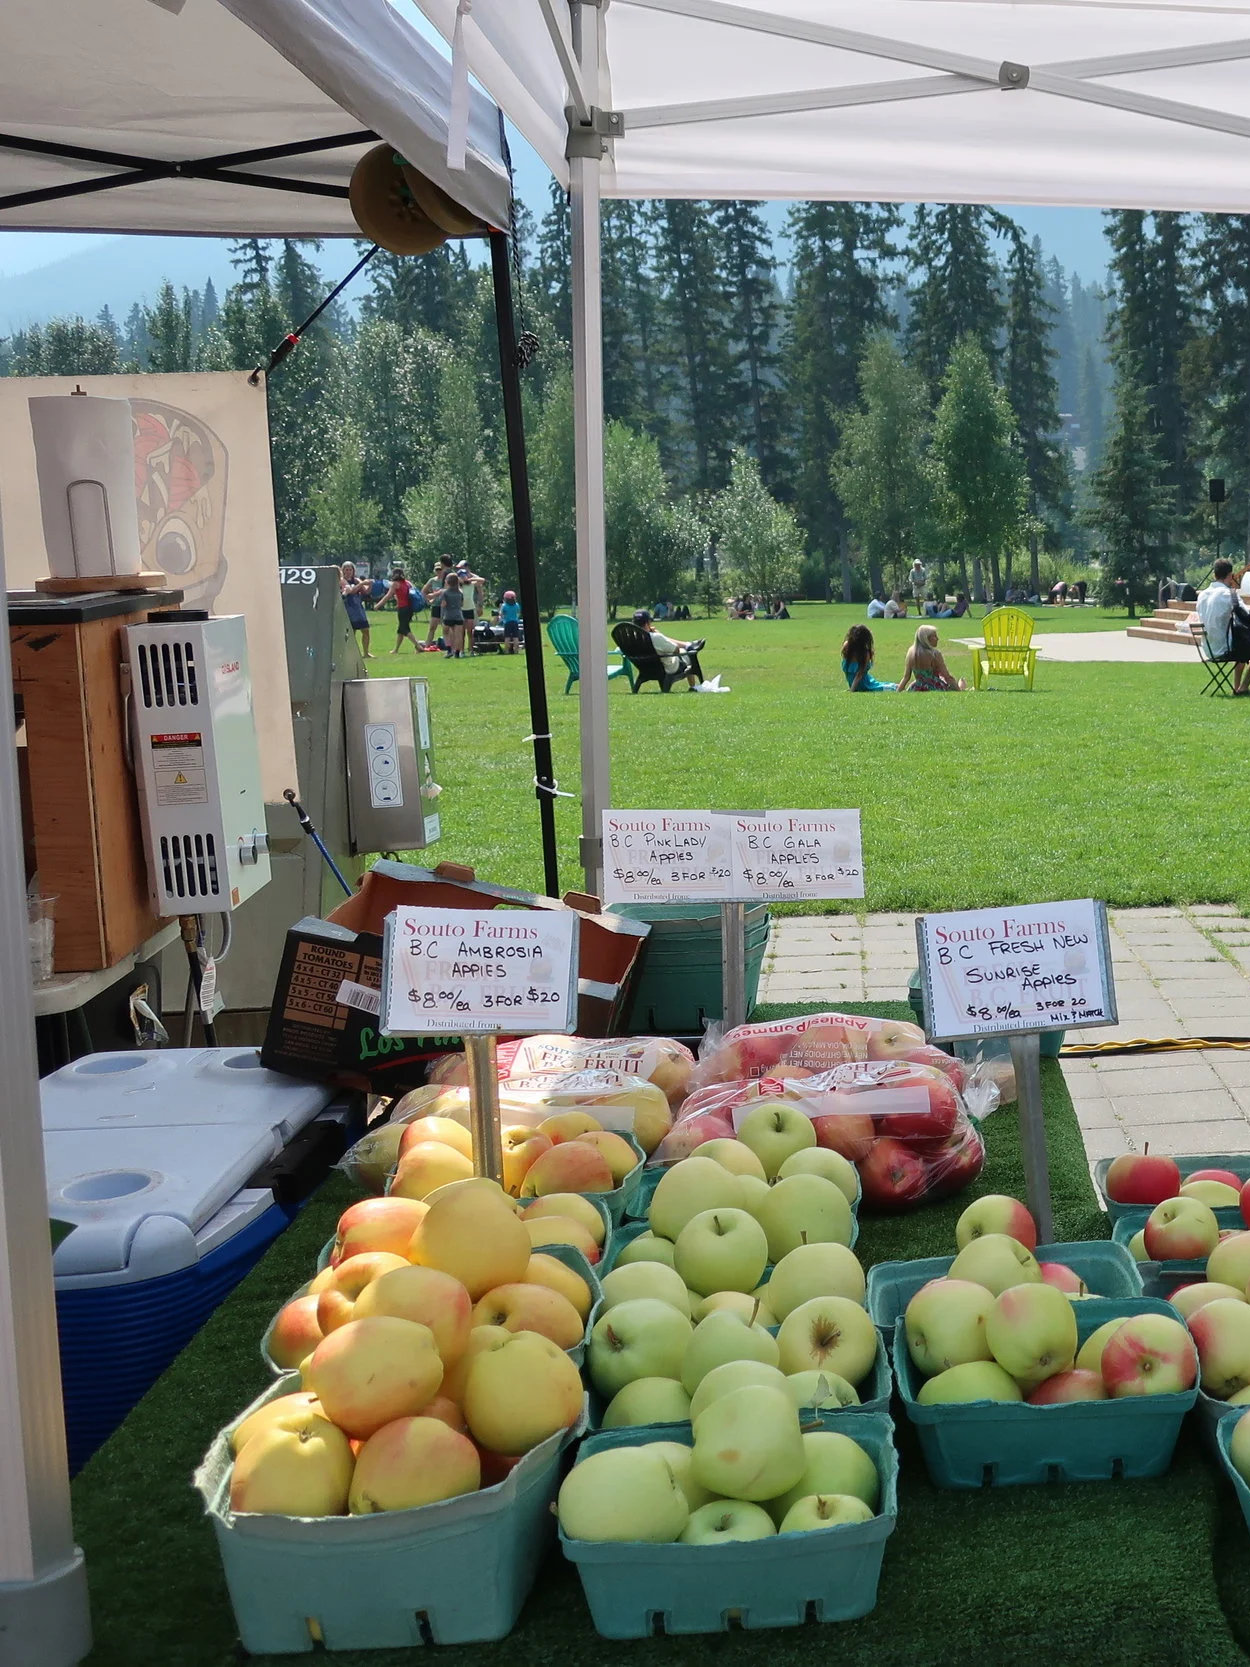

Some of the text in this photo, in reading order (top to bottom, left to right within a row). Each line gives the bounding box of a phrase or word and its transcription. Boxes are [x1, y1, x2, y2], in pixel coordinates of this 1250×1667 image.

[279, 568, 316, 584] 129
[608, 817, 711, 832] Souto Farms
[737, 819, 836, 832] Souto Farms
[784, 836, 821, 848] GALA
[771, 853, 819, 864] APPLES
[710, 867, 731, 877] $20
[838, 867, 859, 876] $20
[403, 918, 538, 939] Souto Farms
[935, 919, 1066, 945] Souto Farms
[311, 945, 345, 959] ROUND
[458, 942, 543, 959] AMBROSIA
[988, 939, 1045, 955] FRESH
[1053, 934, 1089, 949] NEW
[302, 953, 353, 969] TOMATOES
[966, 964, 1041, 983] SUNRISE
[527, 986, 560, 1002] $20
[1071, 998, 1086, 1006] 20
[427, 1019, 475, 1028] Distributed
[973, 1021, 1020, 1032] Distributed
[584, 1058, 644, 1074] FRUIT
